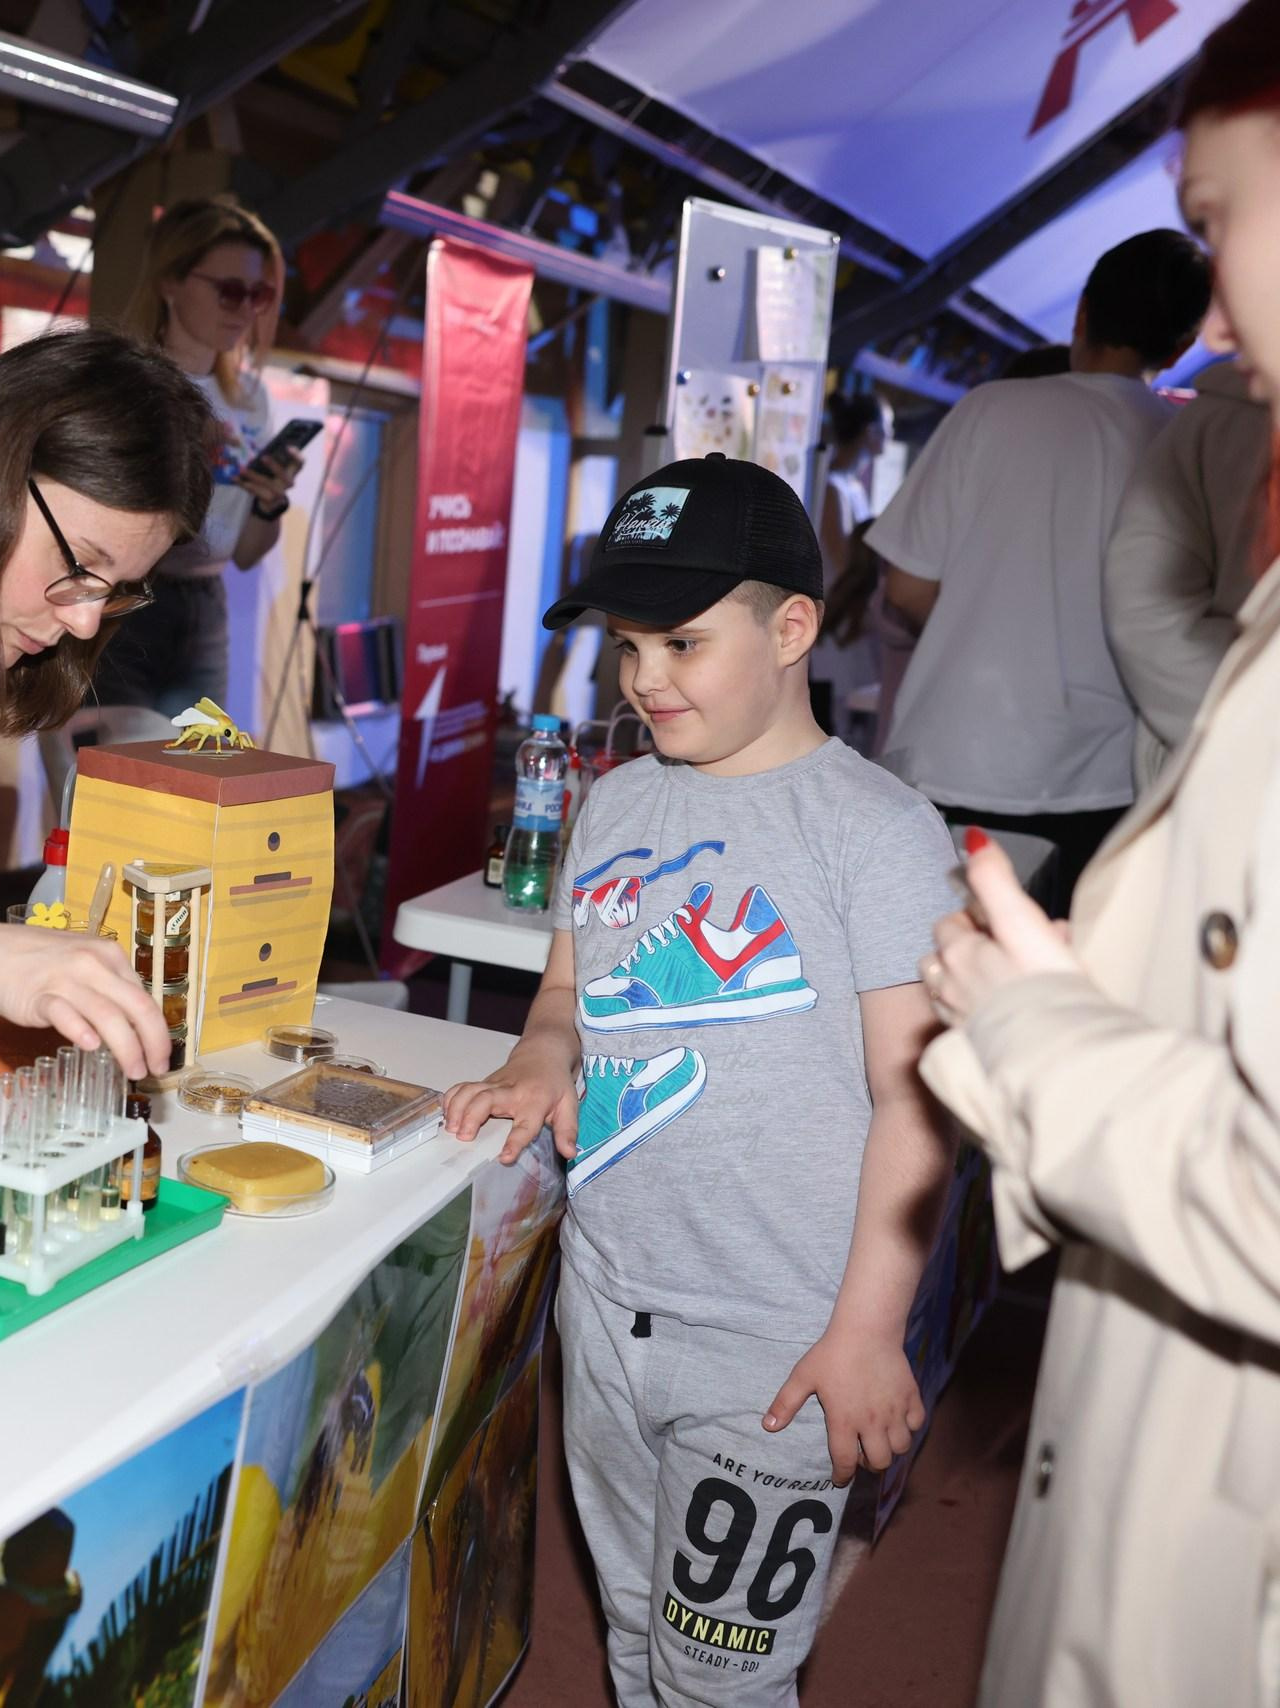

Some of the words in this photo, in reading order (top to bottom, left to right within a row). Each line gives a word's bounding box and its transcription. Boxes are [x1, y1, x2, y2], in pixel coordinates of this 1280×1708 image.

[712, 1453, 747, 1477] ARE
[753, 1470, 788, 1488] YOU
[672, 1477, 833, 1621] 96
[665, 1598, 770, 1653] DYNAMIC
[683, 1645, 730, 1669] STEADY
[741, 1661, 760, 1673] GO!
